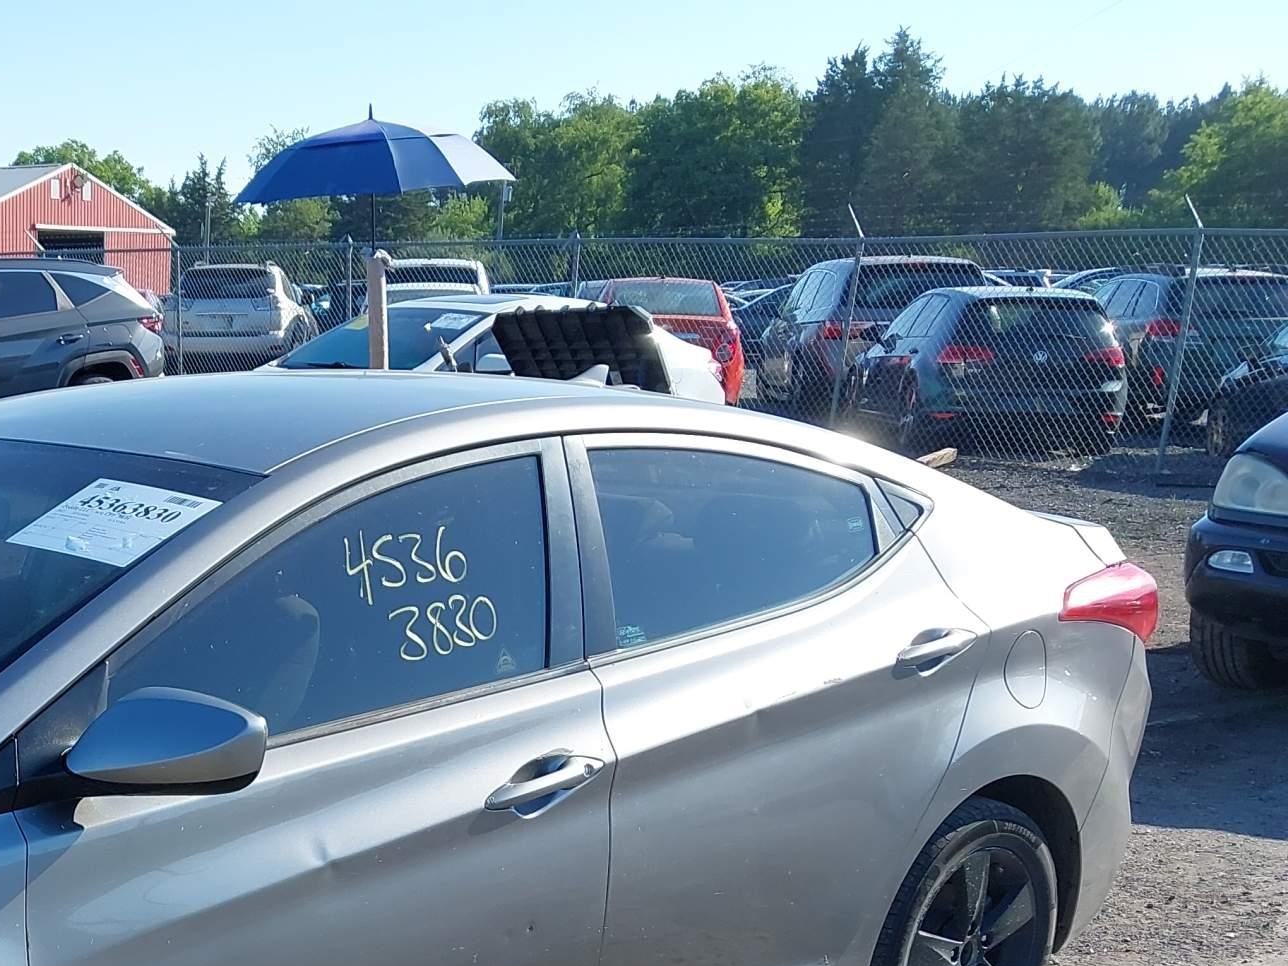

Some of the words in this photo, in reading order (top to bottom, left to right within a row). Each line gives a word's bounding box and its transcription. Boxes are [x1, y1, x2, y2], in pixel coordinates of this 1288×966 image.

[79, 495, 182, 523] 45363830
[343, 526, 468, 606] 4536
[388, 594, 498, 661] 3830
